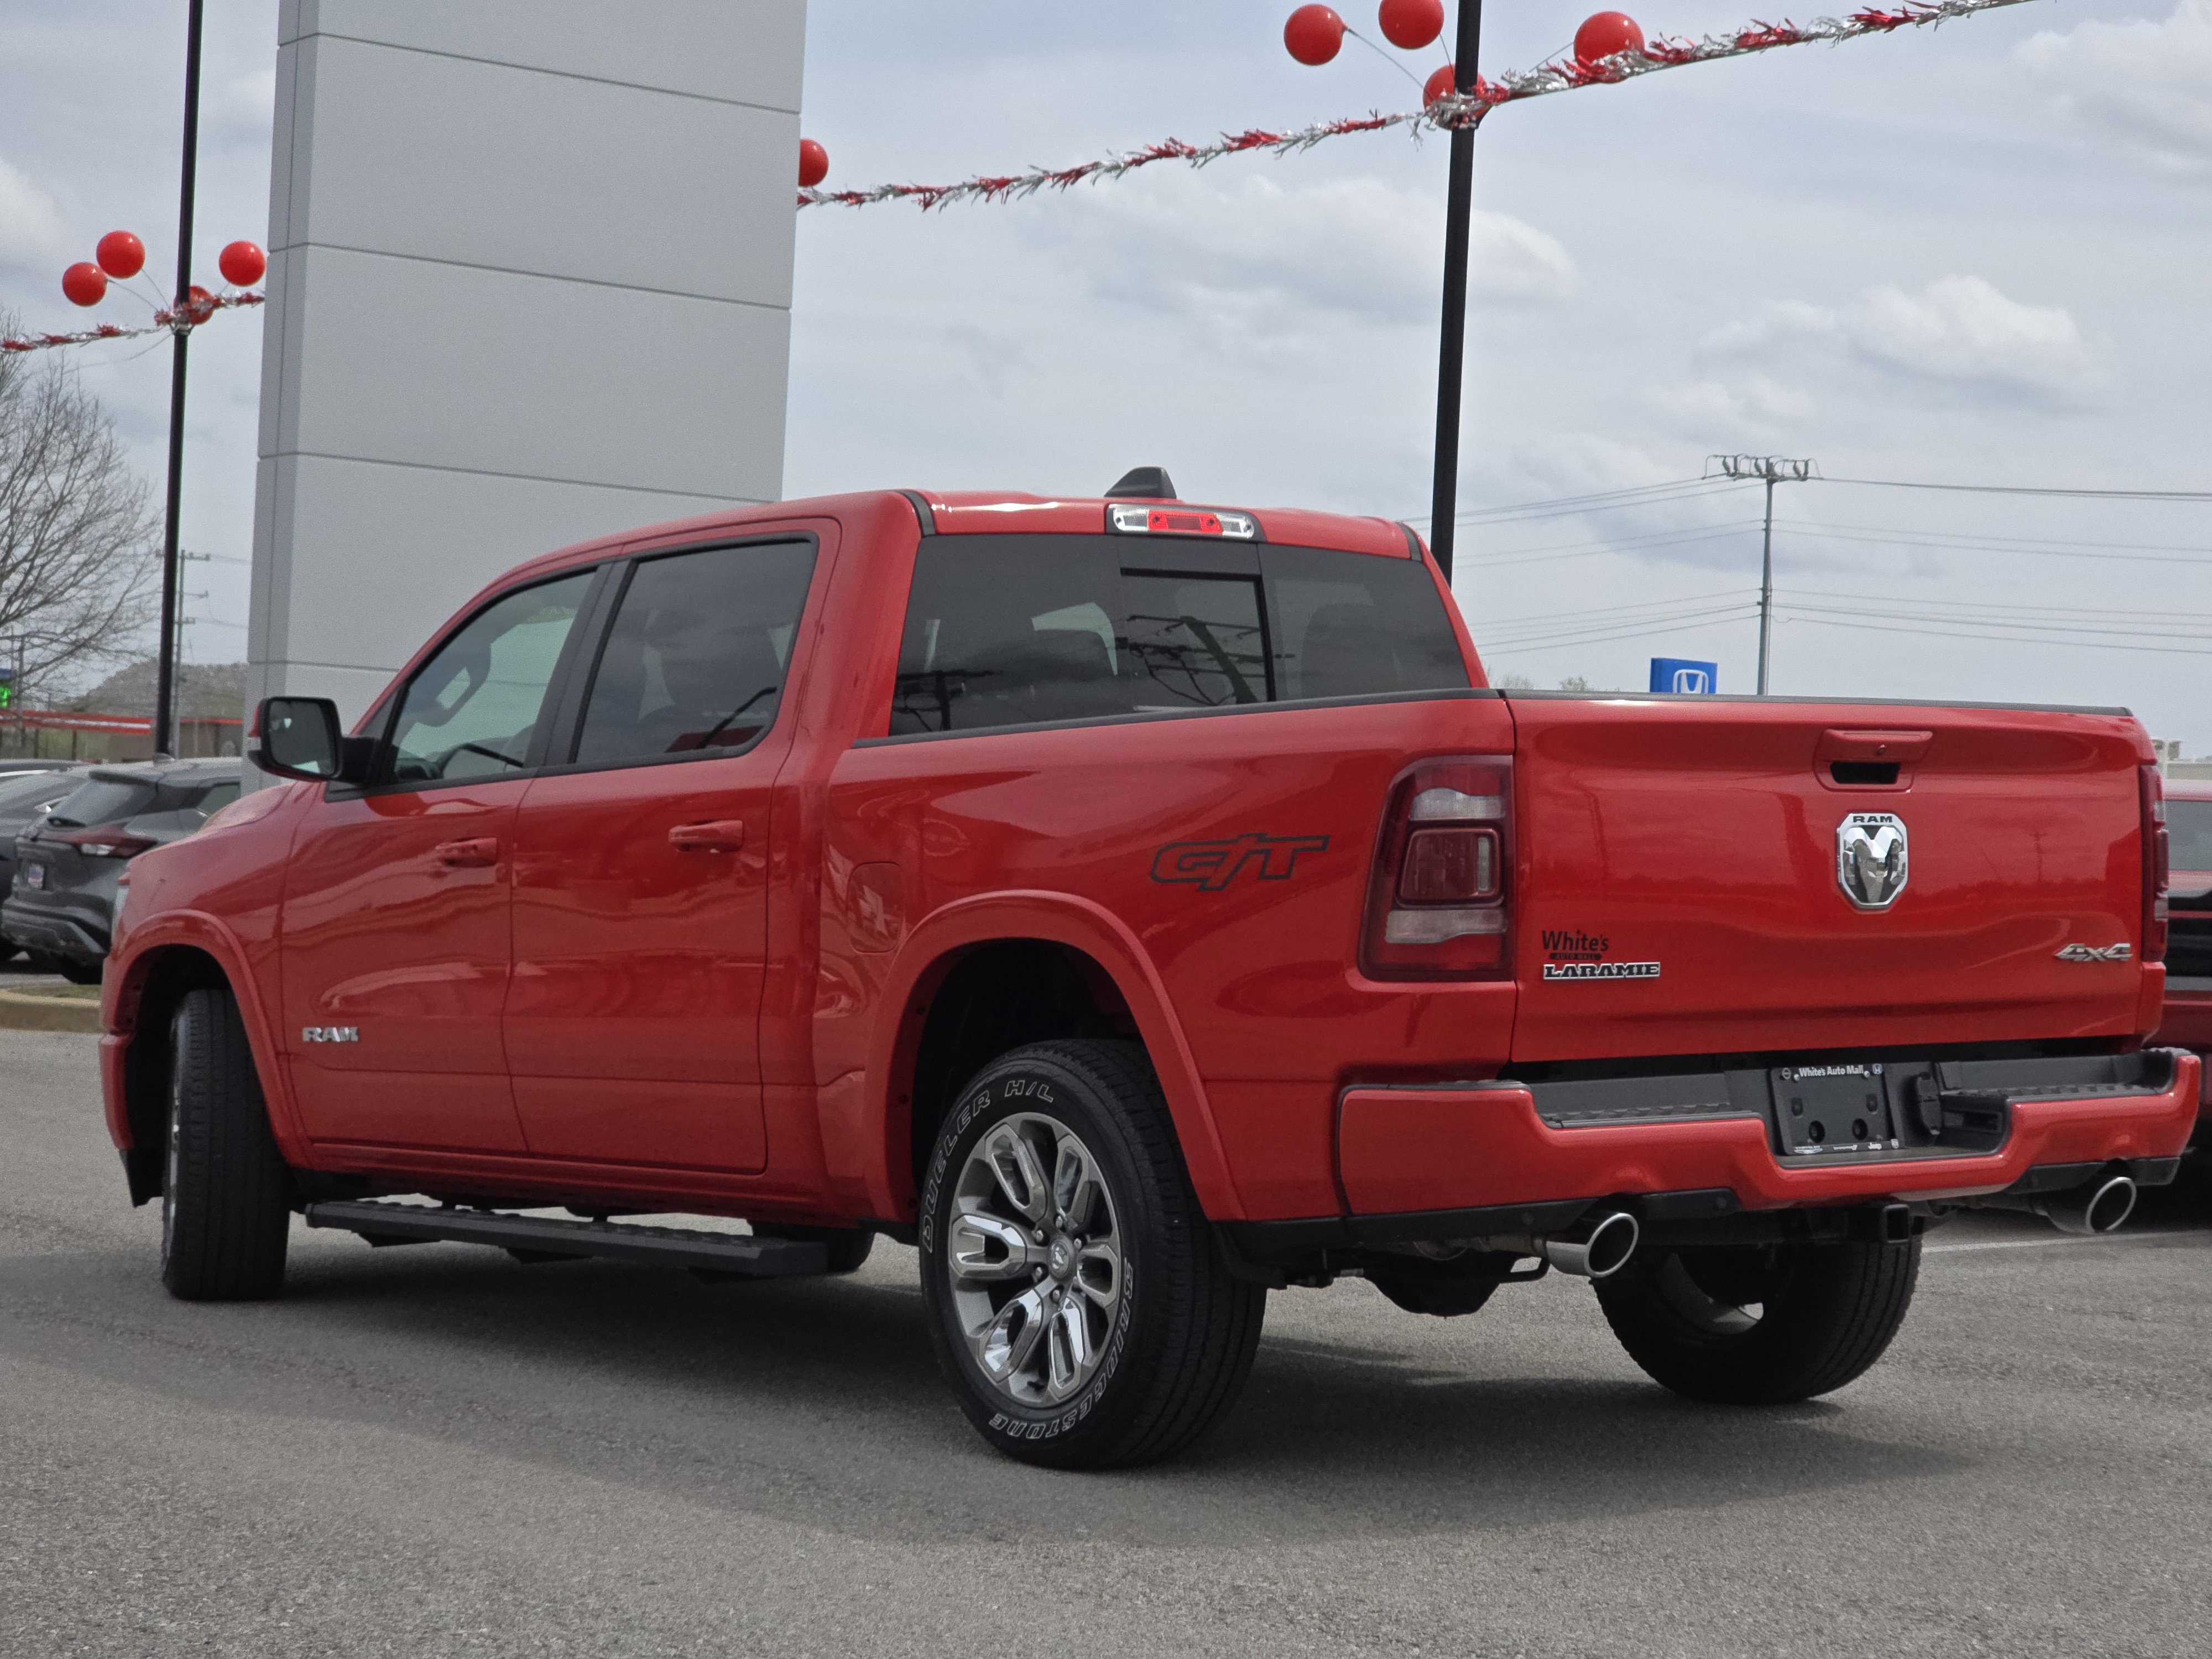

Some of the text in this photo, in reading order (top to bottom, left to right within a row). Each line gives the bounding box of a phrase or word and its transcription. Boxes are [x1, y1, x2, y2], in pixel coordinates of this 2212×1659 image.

[1541, 929, 1609, 952] White's
[1544, 962, 1660, 979] LARAMIE
[302, 1027, 358, 1042] RAM
[1799, 1065, 1864, 1077] White's Auto Mall
[922, 1079, 1053, 1253] DUELER H/L
[989, 1258, 1133, 1439] BRIDGESTONE
